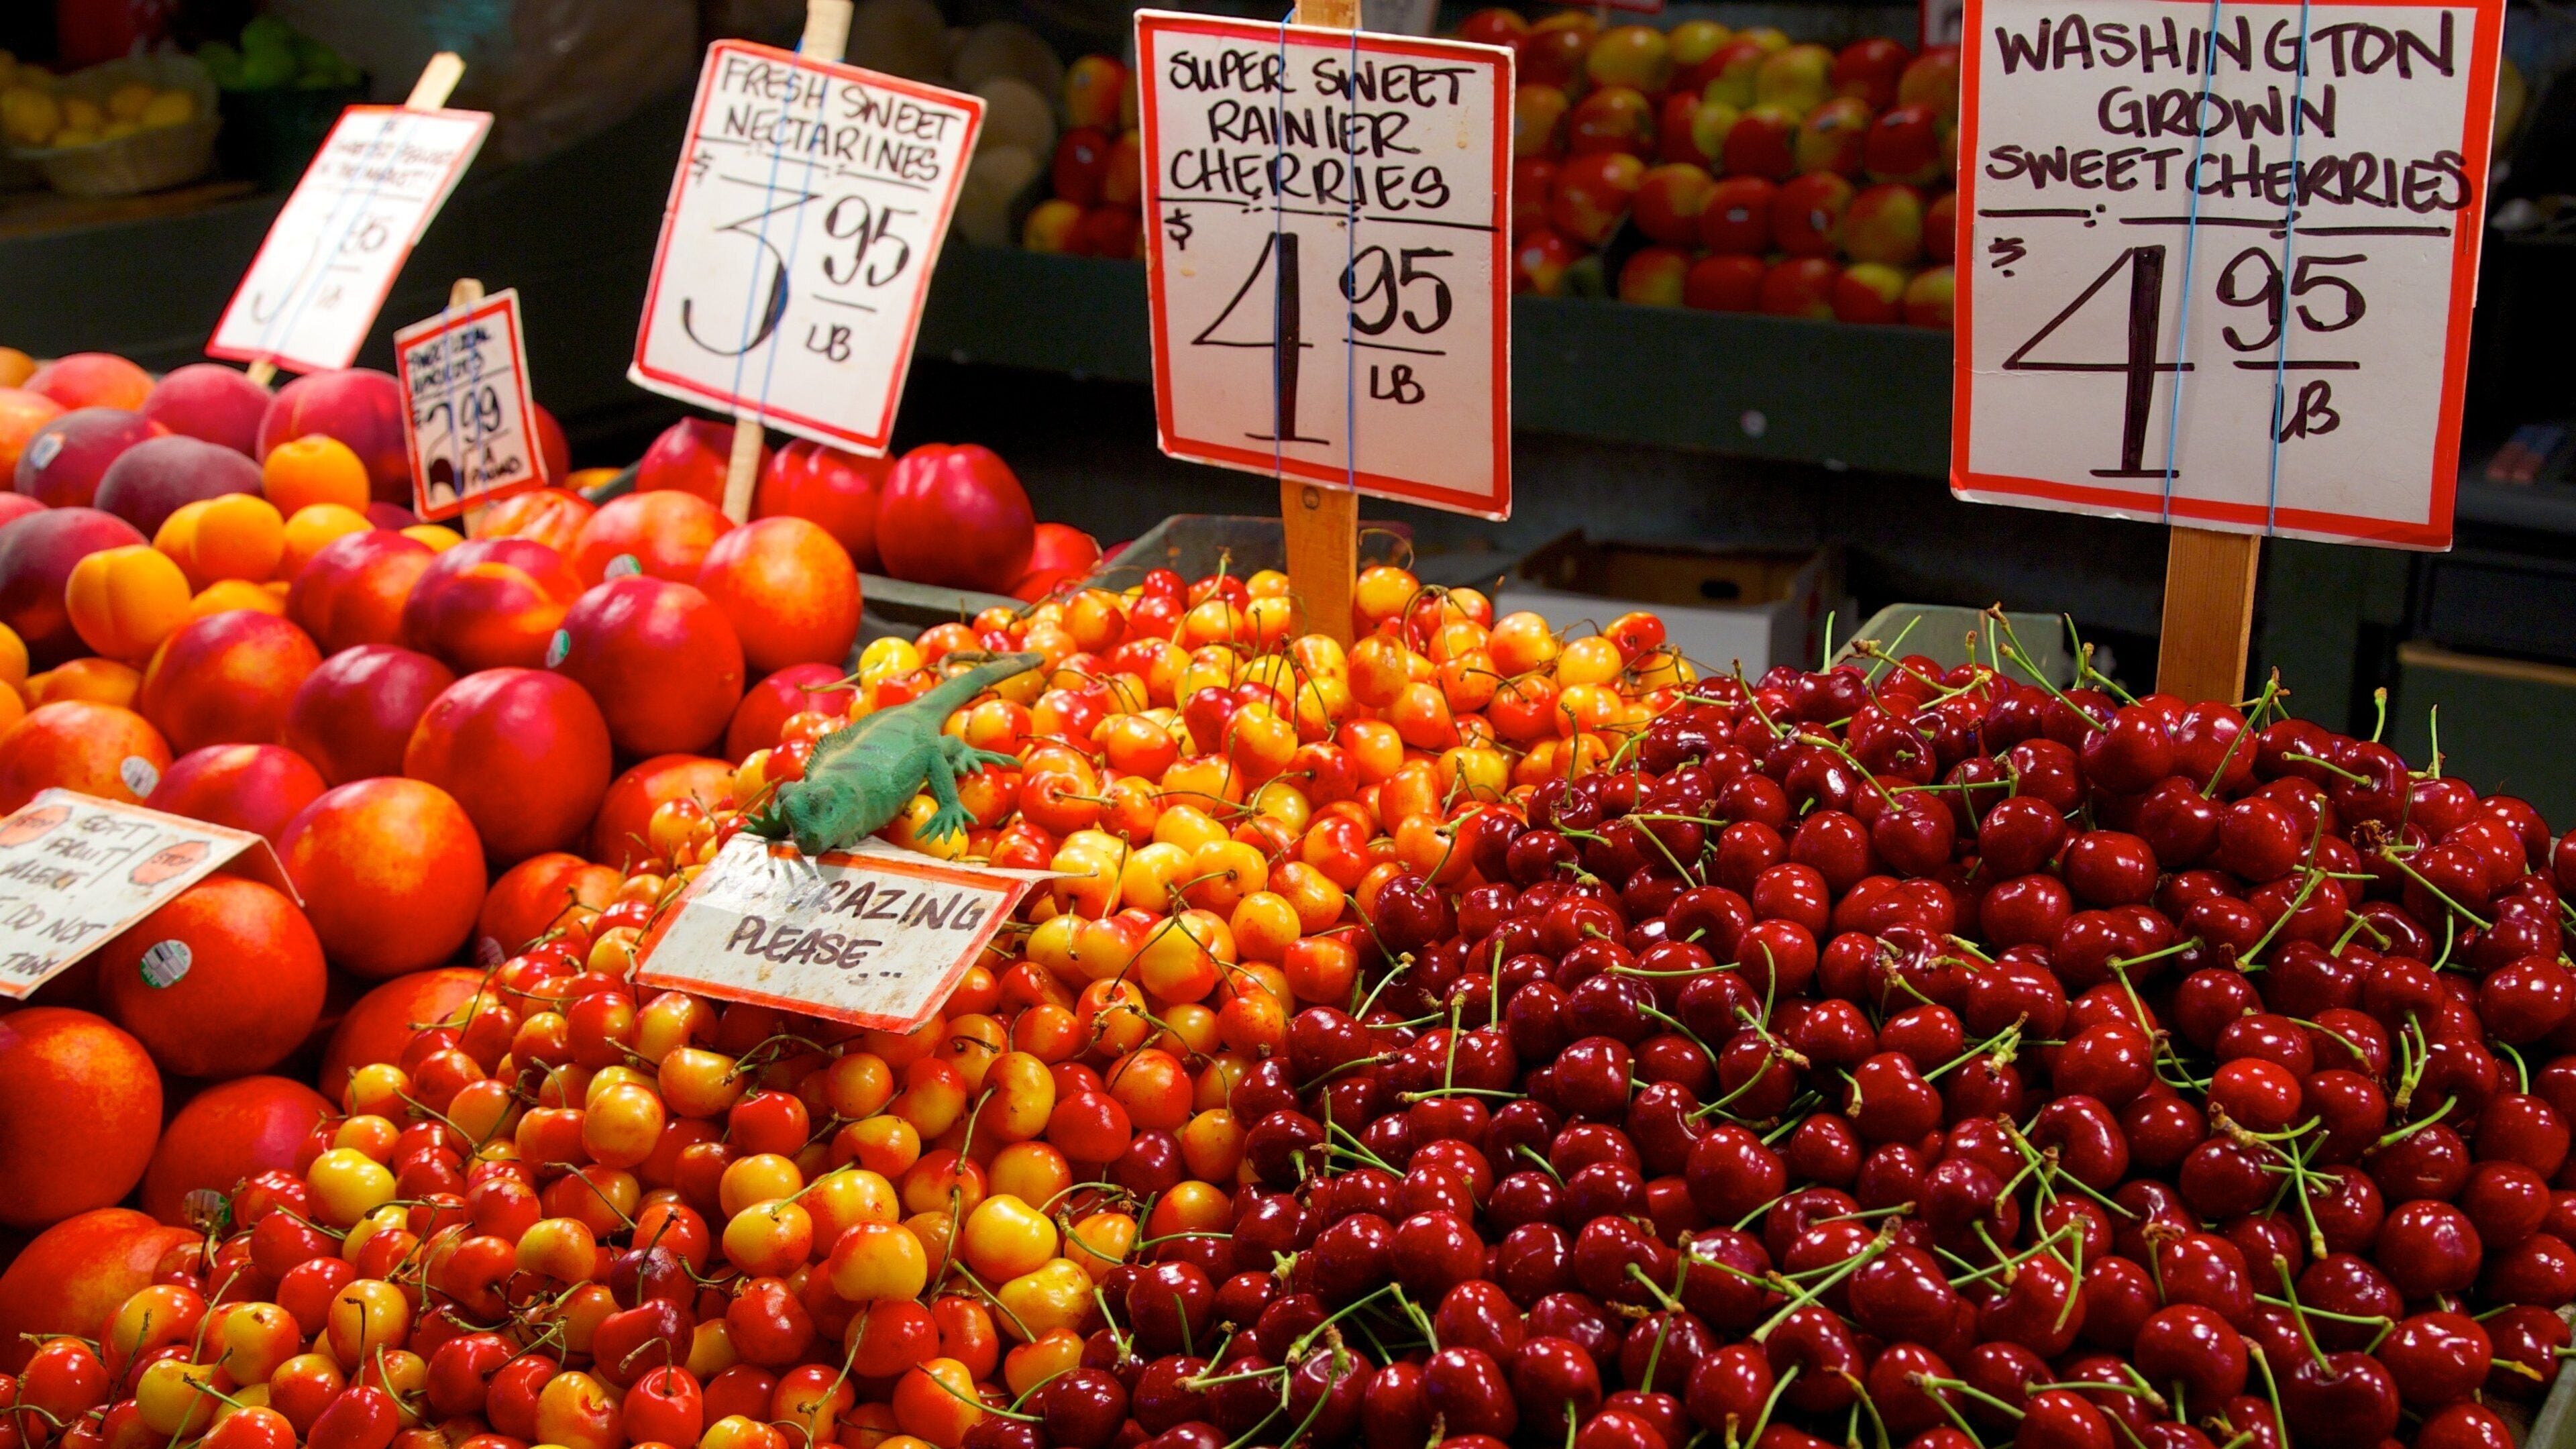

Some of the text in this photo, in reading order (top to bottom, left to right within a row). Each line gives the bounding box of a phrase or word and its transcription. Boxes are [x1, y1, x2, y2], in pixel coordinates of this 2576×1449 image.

[1995, 10, 2454, 79] WASHINGTON
[721, 56, 961, 142] FRESH SWEET
[1169, 49, 1477, 105] SUPER SWEET
[1208, 99, 1421, 156] RAINIER
[2098, 83, 2337, 138] GROWN
[725, 103, 938, 182] NECTARINES
[1169, 148, 1451, 211] CHERRIES
[1984, 144, 2473, 214] SWEET CHERRIES
[682, 175, 823, 357] 3
[824, 195, 918, 287] 95
[804, 323, 851, 362] LB
[1164, 209, 1453, 445] $ 4 95
[1370, 365, 1426, 405] LB
[2002, 244, 2195, 478] 4
[2215, 246, 2367, 352] 95
[460, 386, 500, 443] 99
[2270, 380, 2341, 443] LB
